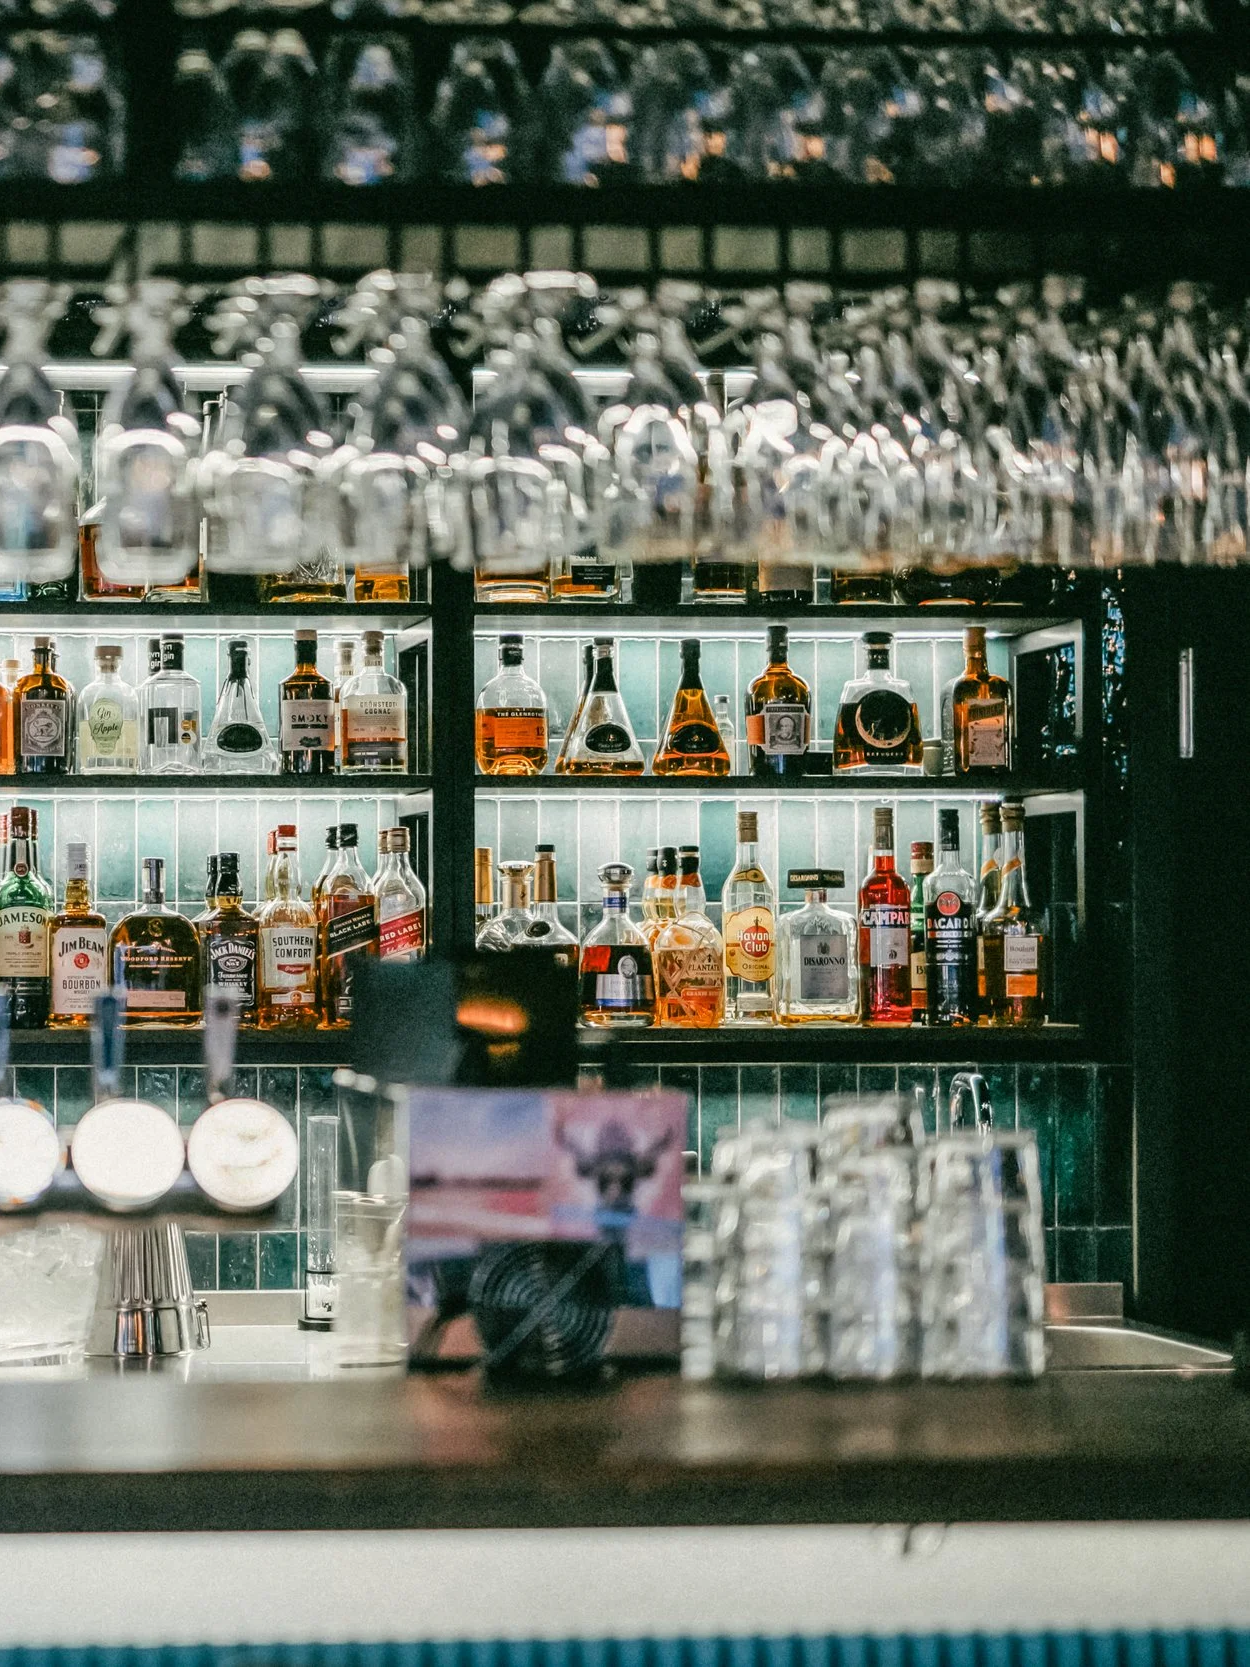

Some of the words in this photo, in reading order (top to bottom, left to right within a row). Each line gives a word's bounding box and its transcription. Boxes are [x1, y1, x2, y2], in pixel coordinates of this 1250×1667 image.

[291, 714, 329, 723] SMOKY
[93, 723, 119, 735] Apple
[861, 910, 910, 926] CAMPAR
[330, 925, 352, 938] BLACK
[379, 931, 396, 943] RED
[397, 922, 422, 936] LABEL
[737, 930, 770, 940] Havan
[58, 941, 77, 957] JIM
[78, 936, 104, 957] BEAM
[272, 935, 314, 947] SOUTHERN
[744, 941, 768, 952] Club
[210, 944, 229, 960] JACK
[275, 948, 312, 958] COMFORT
[803, 956, 846, 966] DISARONNO
[62, 979, 101, 990] BOURBON
